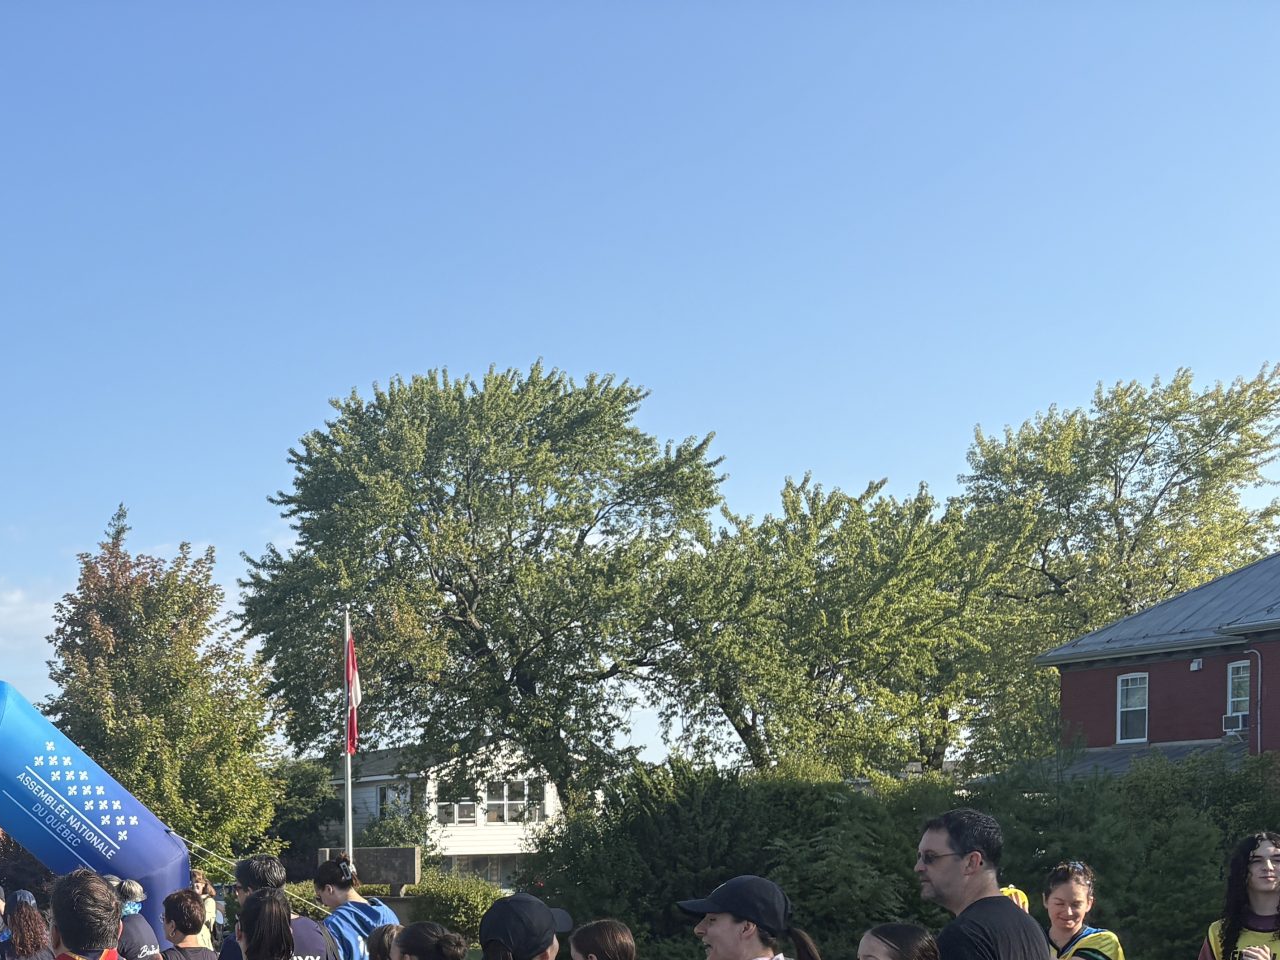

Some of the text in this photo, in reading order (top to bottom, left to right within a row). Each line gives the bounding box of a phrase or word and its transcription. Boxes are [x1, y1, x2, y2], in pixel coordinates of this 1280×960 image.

[16, 772, 116, 860] ASSEMBLÉE NATIONALE
[31, 802, 81, 847] DU QUÉBEC
